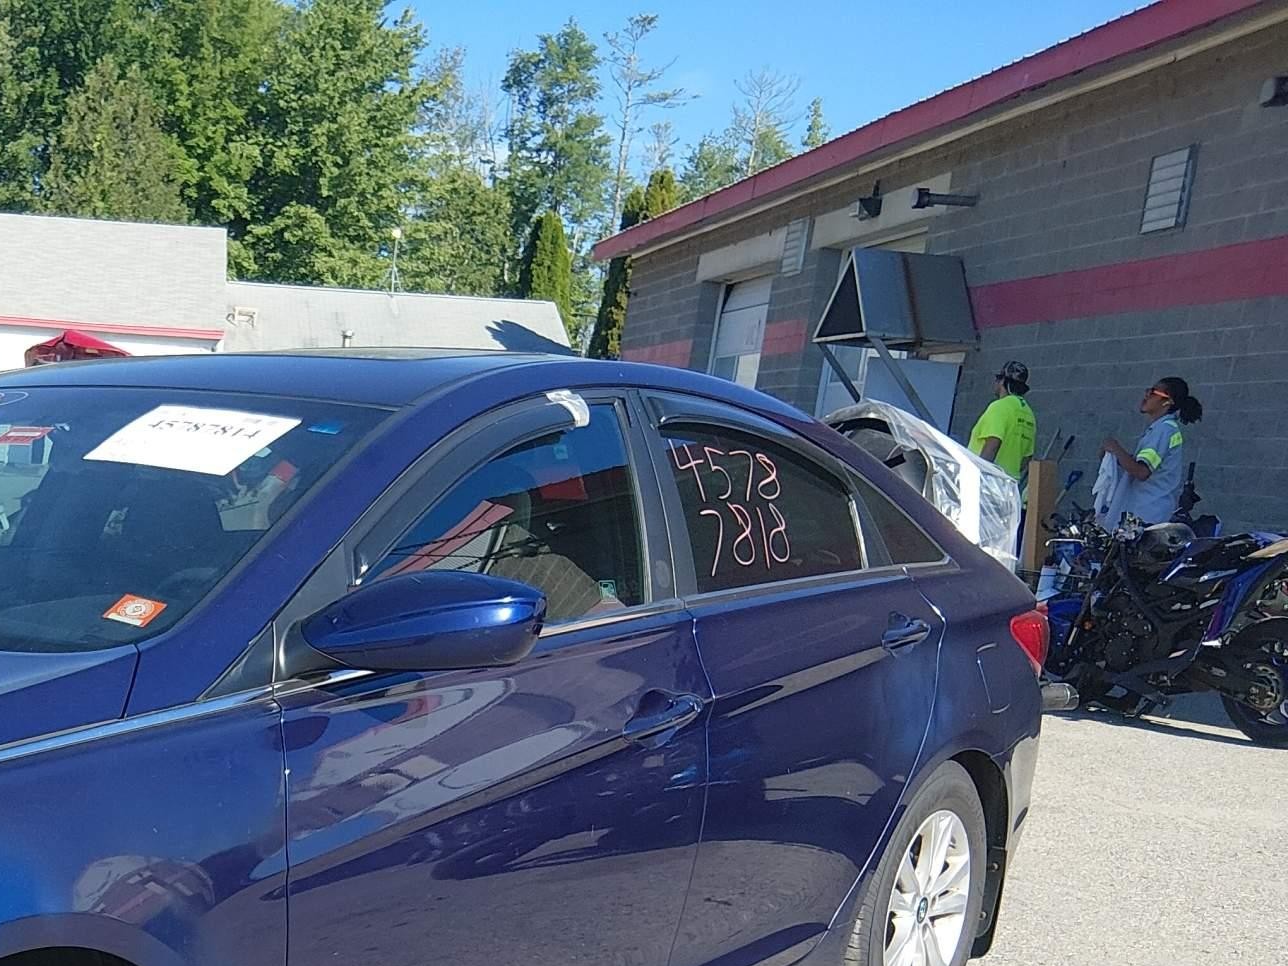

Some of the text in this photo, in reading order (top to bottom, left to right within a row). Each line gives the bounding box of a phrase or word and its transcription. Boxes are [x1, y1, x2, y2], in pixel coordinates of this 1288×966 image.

[148, 418, 262, 440] 45787814
[668, 438, 781, 502] 4578
[699, 501, 790, 577] 7818
